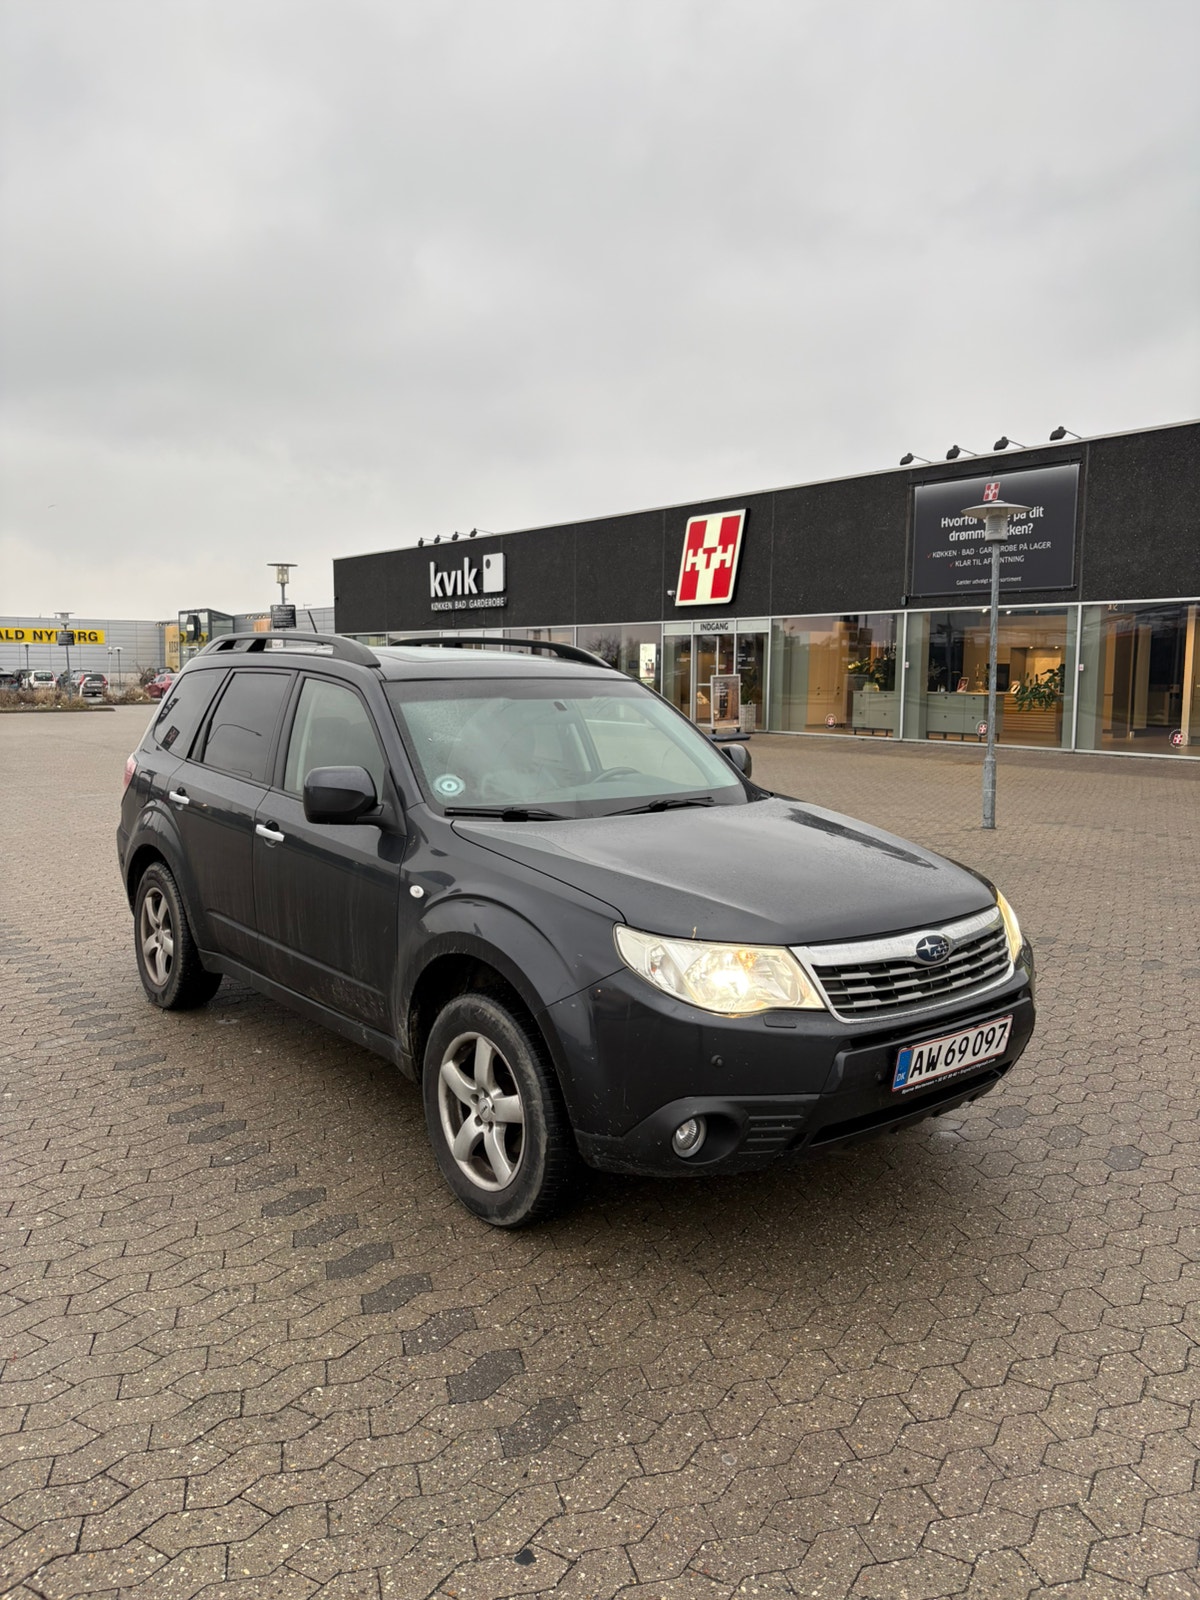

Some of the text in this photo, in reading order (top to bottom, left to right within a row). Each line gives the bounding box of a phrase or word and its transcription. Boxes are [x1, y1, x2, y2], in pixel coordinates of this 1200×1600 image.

[1029, 506, 1044, 518] dit
[932, 541, 1052, 559] KØKKEN BAD GARROBE PÅ LAGER
[955, 555, 1025, 568] KLAR TIL AFNTNING
[430, 557, 478, 597] kvik
[431, 597, 505, 611] KØKKEN BAD GARDEROBE
[700, 622, 729, 631] INDGANG
[33, 630, 98, 642] NYRG
[896, 1073, 905, 1082] DK
